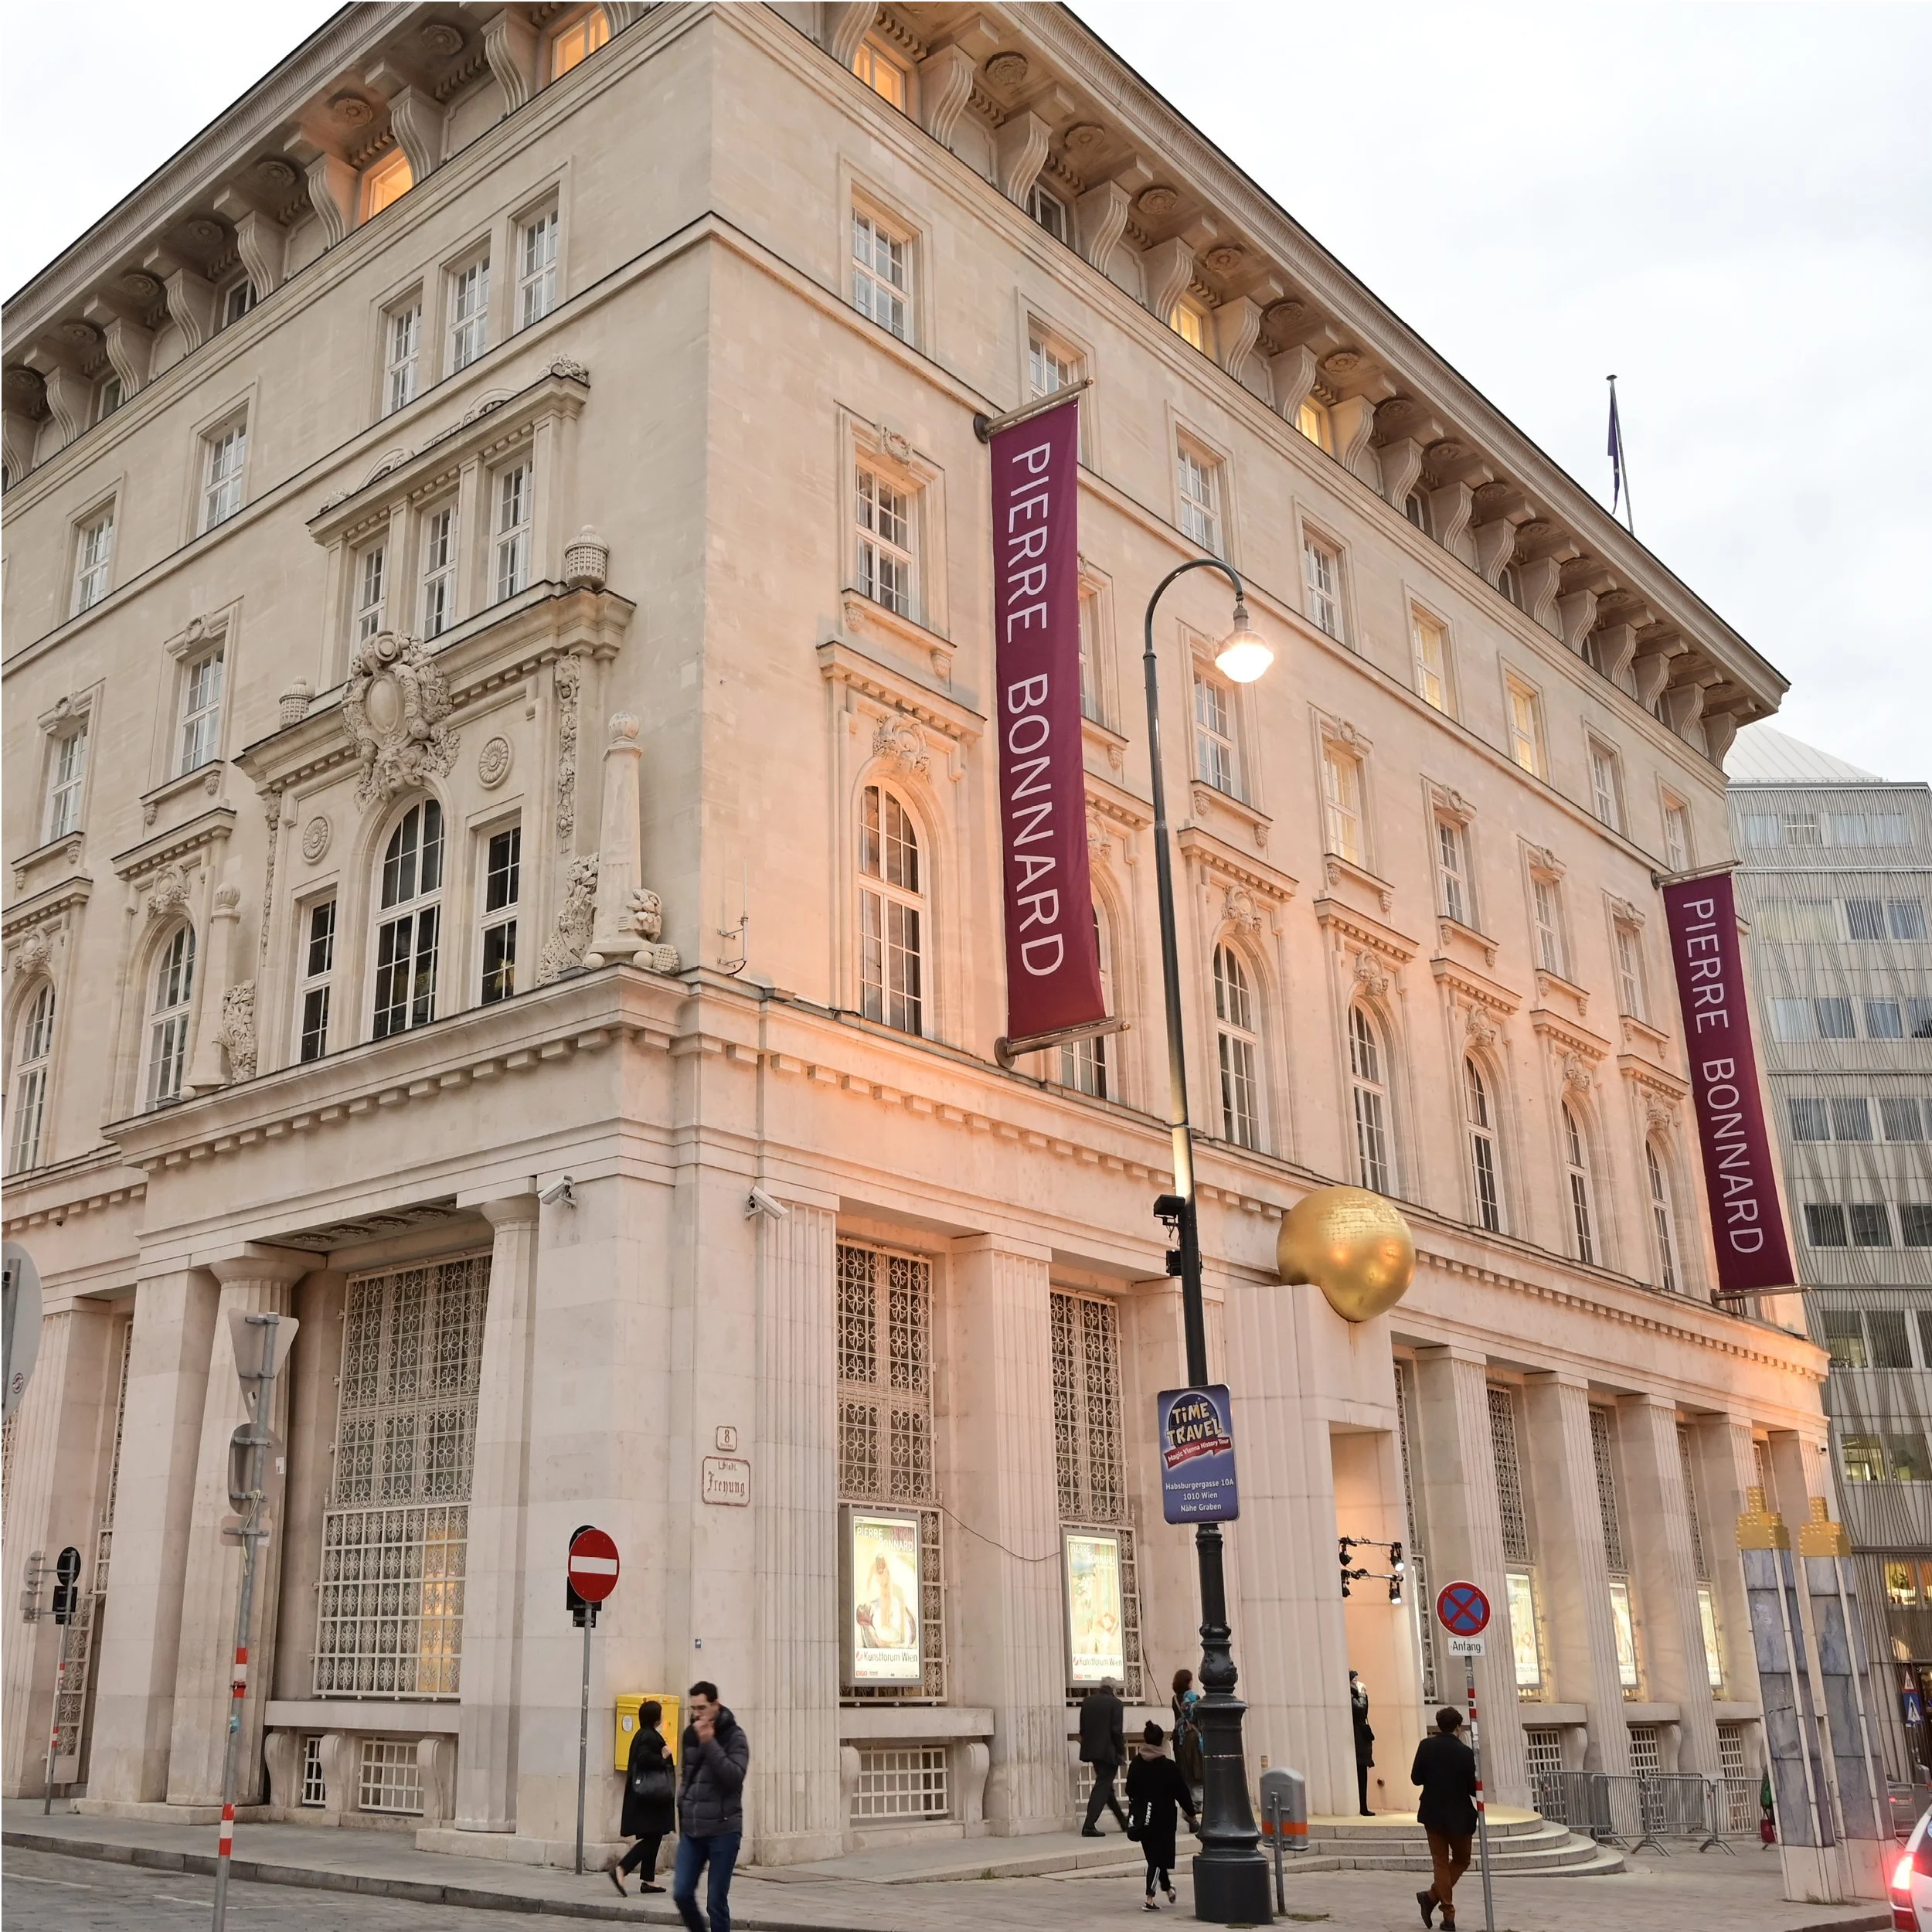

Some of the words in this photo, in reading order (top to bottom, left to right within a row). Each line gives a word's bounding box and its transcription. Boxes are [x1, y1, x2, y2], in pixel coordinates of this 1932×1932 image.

[1007, 442, 1051, 644] PIERRE
[1008, 673, 1064, 976] BONNARD
[1683, 898, 1729, 1034] PIERRE
[1702, 1058, 1764, 1253] BONNARD
[724, 1429, 730, 1443] 8
[1166, 1417, 1223, 1446] TRAVEL
[1168, 1452, 1183, 1462] Magic
[1183, 1445, 1200, 1454] Vienna
[1200, 1440, 1219, 1449] History
[707, 1471, 745, 1497] Freyung
[1165, 1481, 1219, 1491] Habsburgergasse
[1180, 1504, 1197, 1512] Nähe
[856, 1526, 883, 1540] PIERRE
[1070, 1543, 1090, 1553] PIERRE
[863, 1651, 900, 1662] Kunstforum
[902, 1651, 918, 1662] Wien
[1452, 1641, 1481, 1654] Anfang
[1080, 1657, 1108, 1666] Kunstforum
[1109, 1657, 1123, 1667] Wien
[1144, 1801, 1152, 1826] KANGOL
